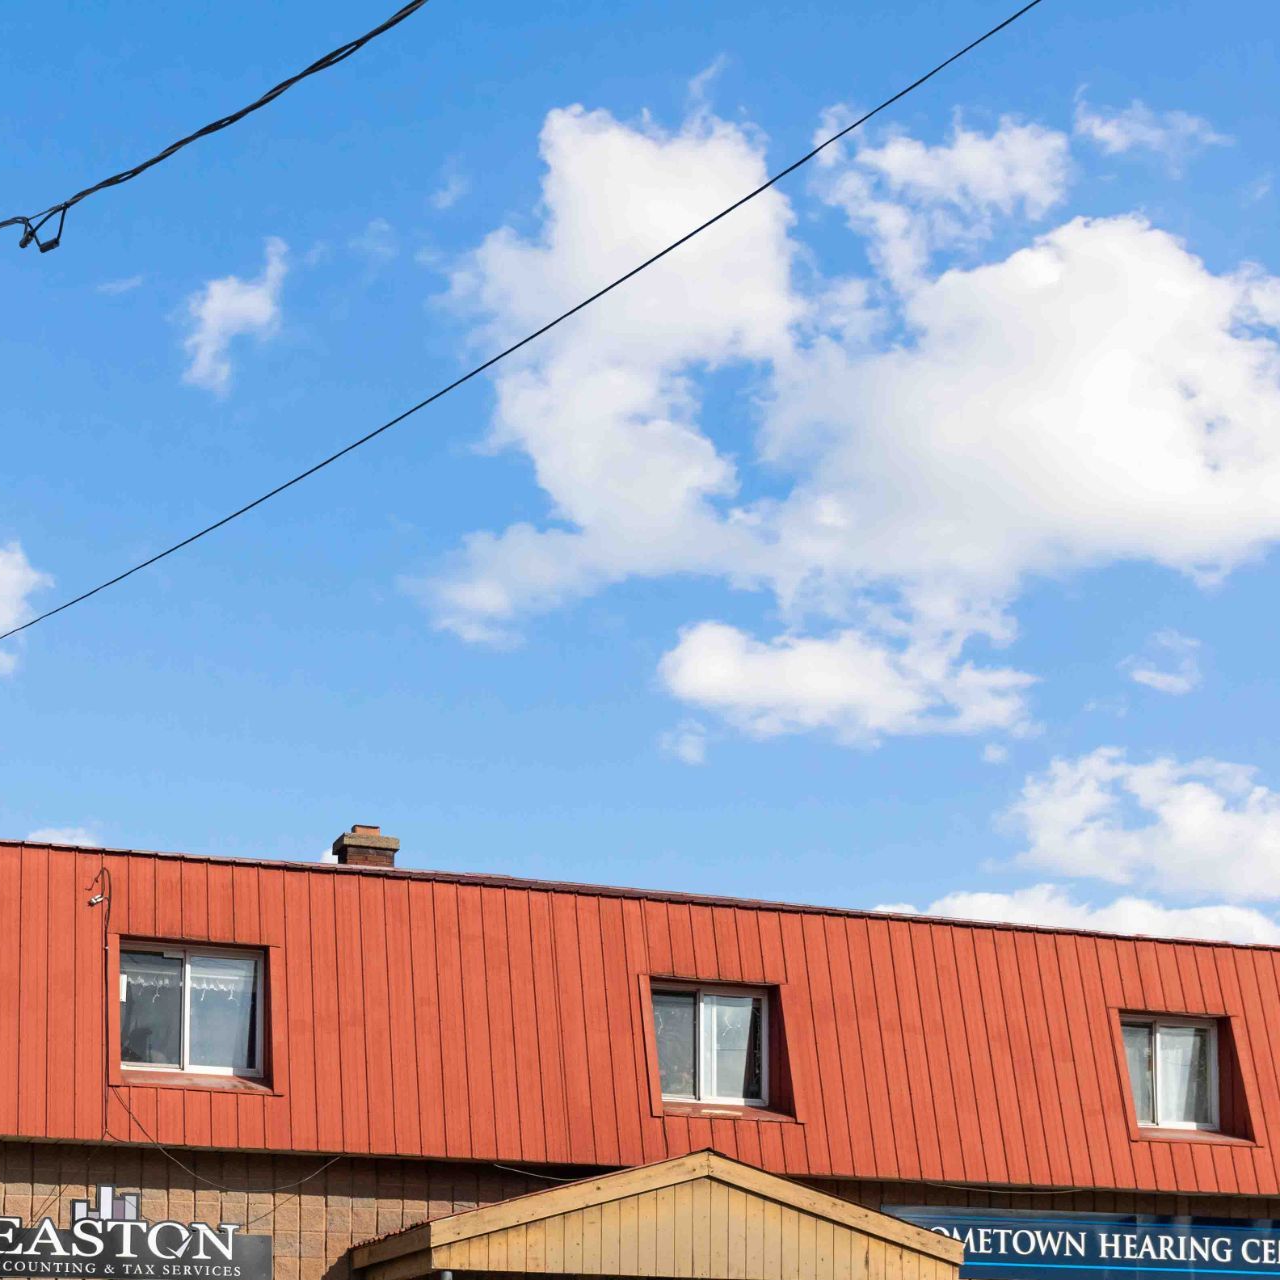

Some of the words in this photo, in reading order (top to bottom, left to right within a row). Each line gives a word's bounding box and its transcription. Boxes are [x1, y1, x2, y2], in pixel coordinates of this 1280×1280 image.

[927, 1226, 1087, 1257] METOWN
[1099, 1233, 1232, 1263] HEARING
[104, 1264, 115, 1274] &
[122, 1263, 155, 1275] TAX
[162, 1264, 241, 1277] SERVICES
